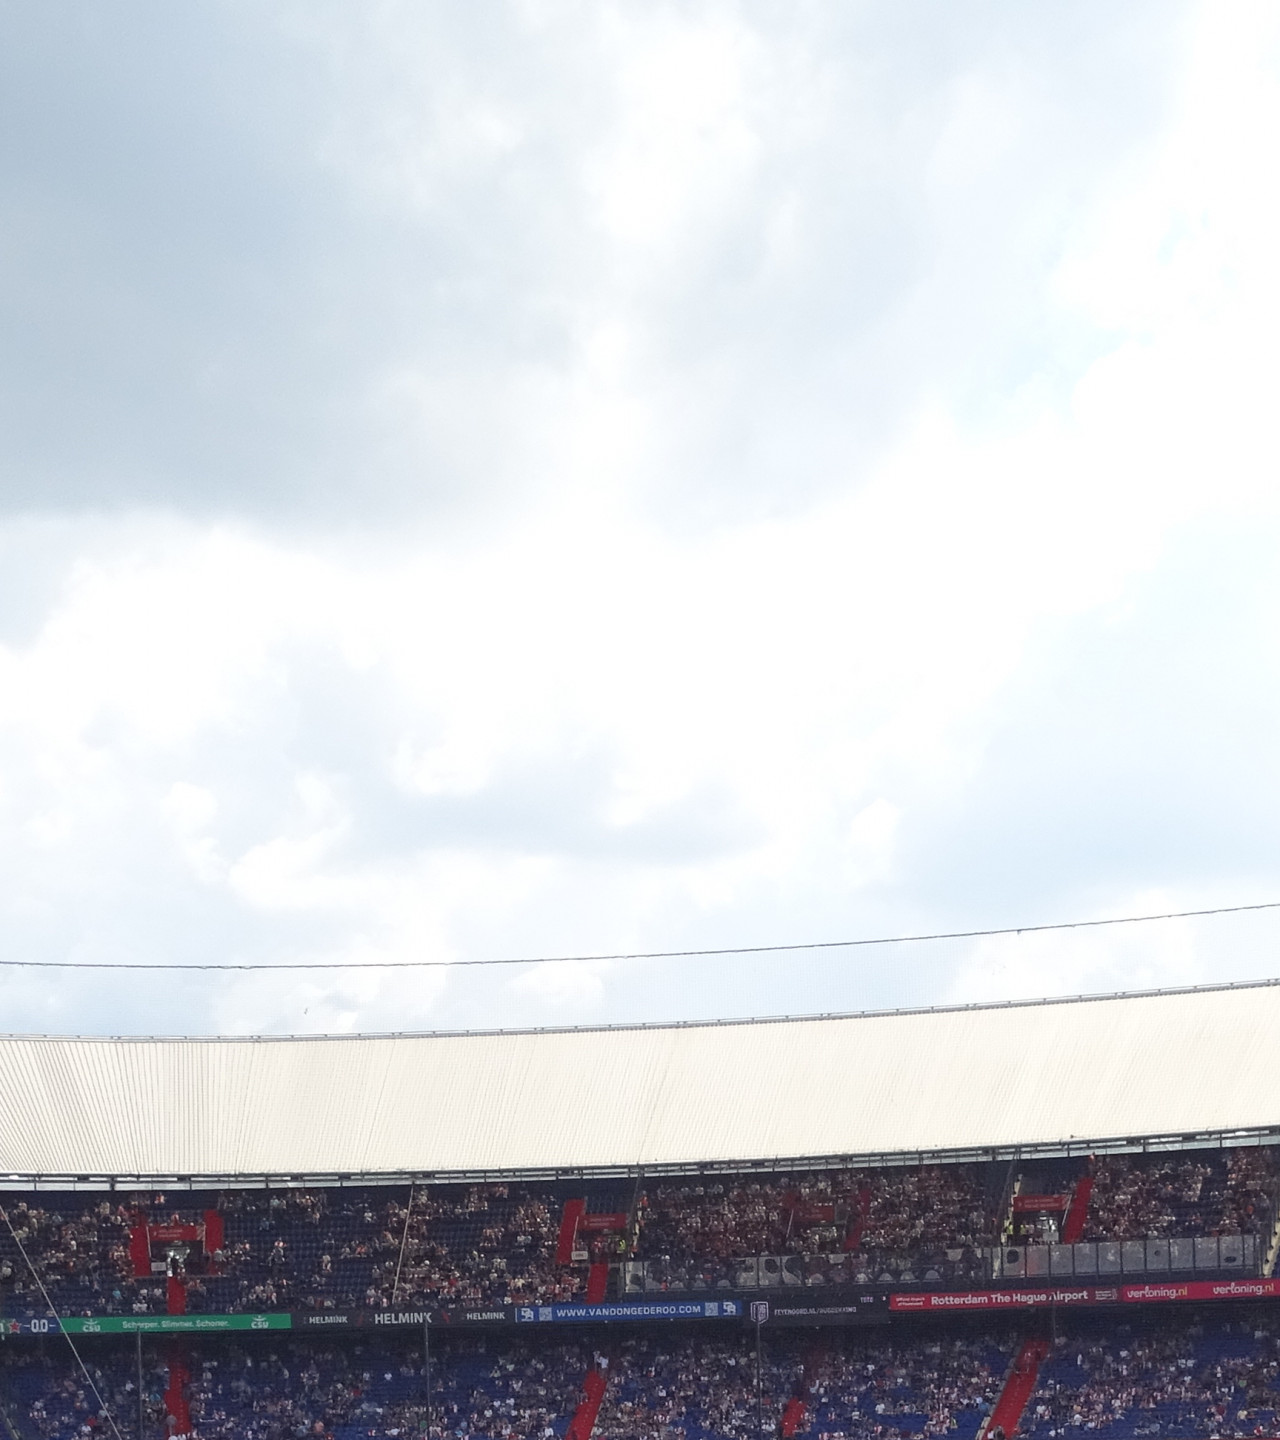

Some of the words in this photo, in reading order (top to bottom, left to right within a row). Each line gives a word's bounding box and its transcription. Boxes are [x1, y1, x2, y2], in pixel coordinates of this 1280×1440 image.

[1127, 1286, 1188, 1299] verloning.nl
[1213, 1283, 1274, 1296] verloning.nl
[931, 1294, 988, 1305] Rotterdam
[991, 1294, 1010, 1303] The
[1013, 1292, 1046, 1304] Hague
[309, 1315, 348, 1324] HELMINK
[374, 1312, 432, 1324] HELMINK
[467, 1311, 505, 1321] HELMINK
